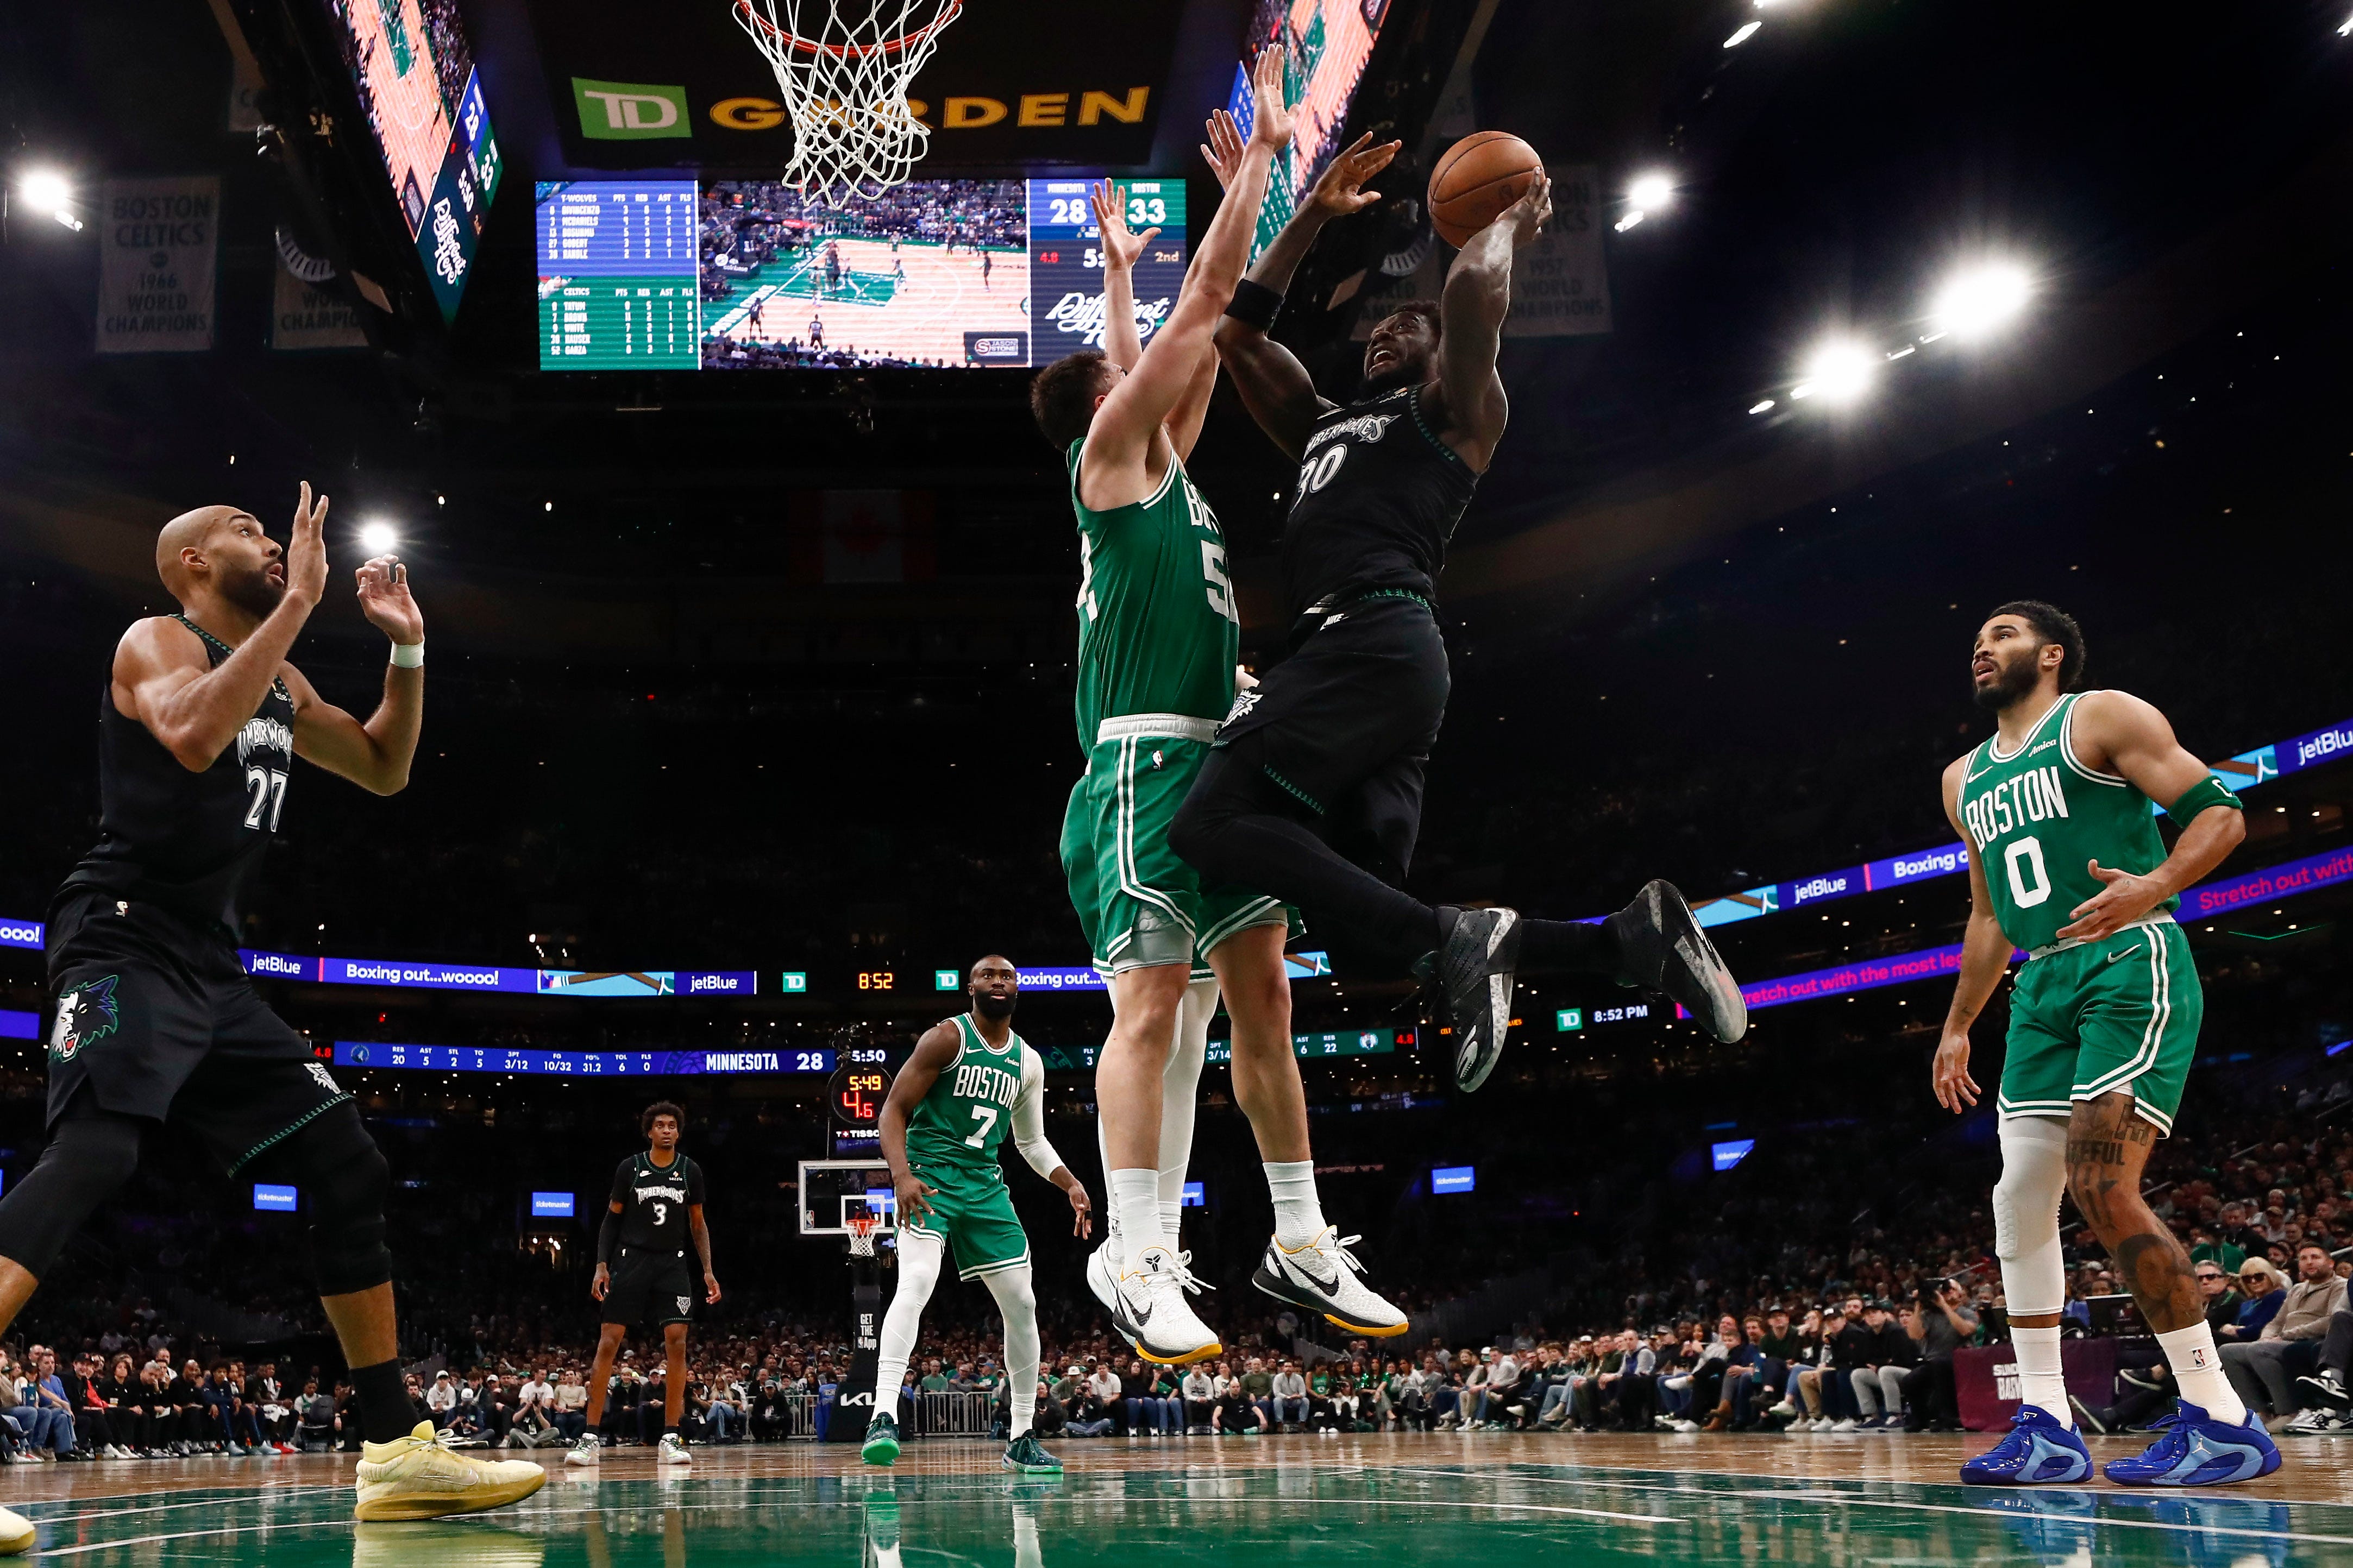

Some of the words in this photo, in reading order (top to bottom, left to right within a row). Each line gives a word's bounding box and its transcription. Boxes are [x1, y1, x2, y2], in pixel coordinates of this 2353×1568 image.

[584, 90, 679, 129] TD
[1046, 183, 1086, 193] MINNESOTA
[1131, 183, 1161, 193] BOSTON
[114, 195, 211, 218] BOSTON
[1049, 199, 1088, 224] 28
[1128, 198, 1166, 224] 33
[644, 216, 650, 226] 2
[666, 216, 672, 225] 2
[115, 223, 205, 248] CELTICS
[667, 228, 671, 237] 1
[624, 249, 629, 259] 2
[645, 249, 650, 259] 2
[667, 249, 671, 259] 1
[1039, 252, 1060, 263] 4.8
[1083, 248, 1105, 268] 5:
[1154, 251, 1180, 262] 2nd
[140, 274, 177, 290] 1966
[1521, 279, 1583, 297] WORLD
[128, 294, 188, 312] WORLD
[668, 301, 672, 310] 1
[105, 314, 206, 333] CHAMPIONS
[552, 313, 557, 322] 7
[647, 312, 652, 322] 2
[669, 312, 673, 321] 1
[625, 323, 630, 332] 7
[647, 323, 652, 332] 2
[669, 323, 673, 331] 1
[626, 333, 631, 343] 2
[647, 345, 652, 354] 2
[669, 345, 673, 354] 1
[688, 344, 693, 354] 2
[2028, 739, 2057, 758] Amica
[2297, 729, 2353, 766] jetBlu
[244, 763, 289, 833] 27
[1965, 766, 2069, 854] BOSTON
[1794, 878, 1847, 904] jetBlue
[1892, 852, 1956, 879] Boxing
[2004, 835, 2051, 909] 0
[2199, 877, 2273, 911] Stretch
[2276, 867, 2311, 889] out
[252, 954, 302, 974] jetBlue
[346, 963, 400, 984] Boxing
[1790, 979, 1818, 996] out
[1821, 970, 1859, 991] with
[1860, 965, 1889, 985] the
[1891, 955, 1937, 977] most
[690, 975, 737, 992] jetBlue
[785, 975, 805, 988] TD
[859, 973, 893, 989] 8:52
[938, 973, 957, 987] TD
[1559, 1012, 1580, 1027] TD
[1593, 1008, 1623, 1023] 8:52
[1626, 1005, 1648, 1019] PM
[1087, 1056, 1093, 1066] 3
[1208, 1050, 1231, 1060] 3/14
[1300, 1045, 1308, 1055] 6
[1324, 1043, 1337, 1053] 22
[1396, 1034, 1414, 1044] 4.8
[314, 1047, 331, 1058] 4.8
[392, 1055, 405, 1065] 20
[423, 1056, 429, 1066] 5
[450, 1057, 457, 1067] 2
[476, 1059, 483, 1068] 5
[505, 1059, 528, 1070] 3/12
[544, 1061, 572, 1072] 10/32
[582, 1062, 601, 1073] 31.2
[619, 1062, 626, 1072] 6
[643, 1062, 650, 1072] 0
[706, 1053, 779, 1070] MINNESOTA
[796, 1053, 824, 1070] 28
[851, 1049, 886, 1062] 5:50
[849, 1075, 882, 1091] 5:49
[952, 1065, 1020, 1111] BOSTON
[849, 1129, 880, 1138] TISSO
[964, 1105, 997, 1149] 7
[1436, 1176, 1471, 1185] ticketmaster
[257, 1193, 294, 1202] ticketmaster
[634, 1185, 687, 1205] TIMBERWOLVES
[652, 1202, 668, 1226] 3
[860, 1314, 873, 1325] GET
[860, 1325, 874, 1336] THE
[864, 1337, 877, 1351] App
